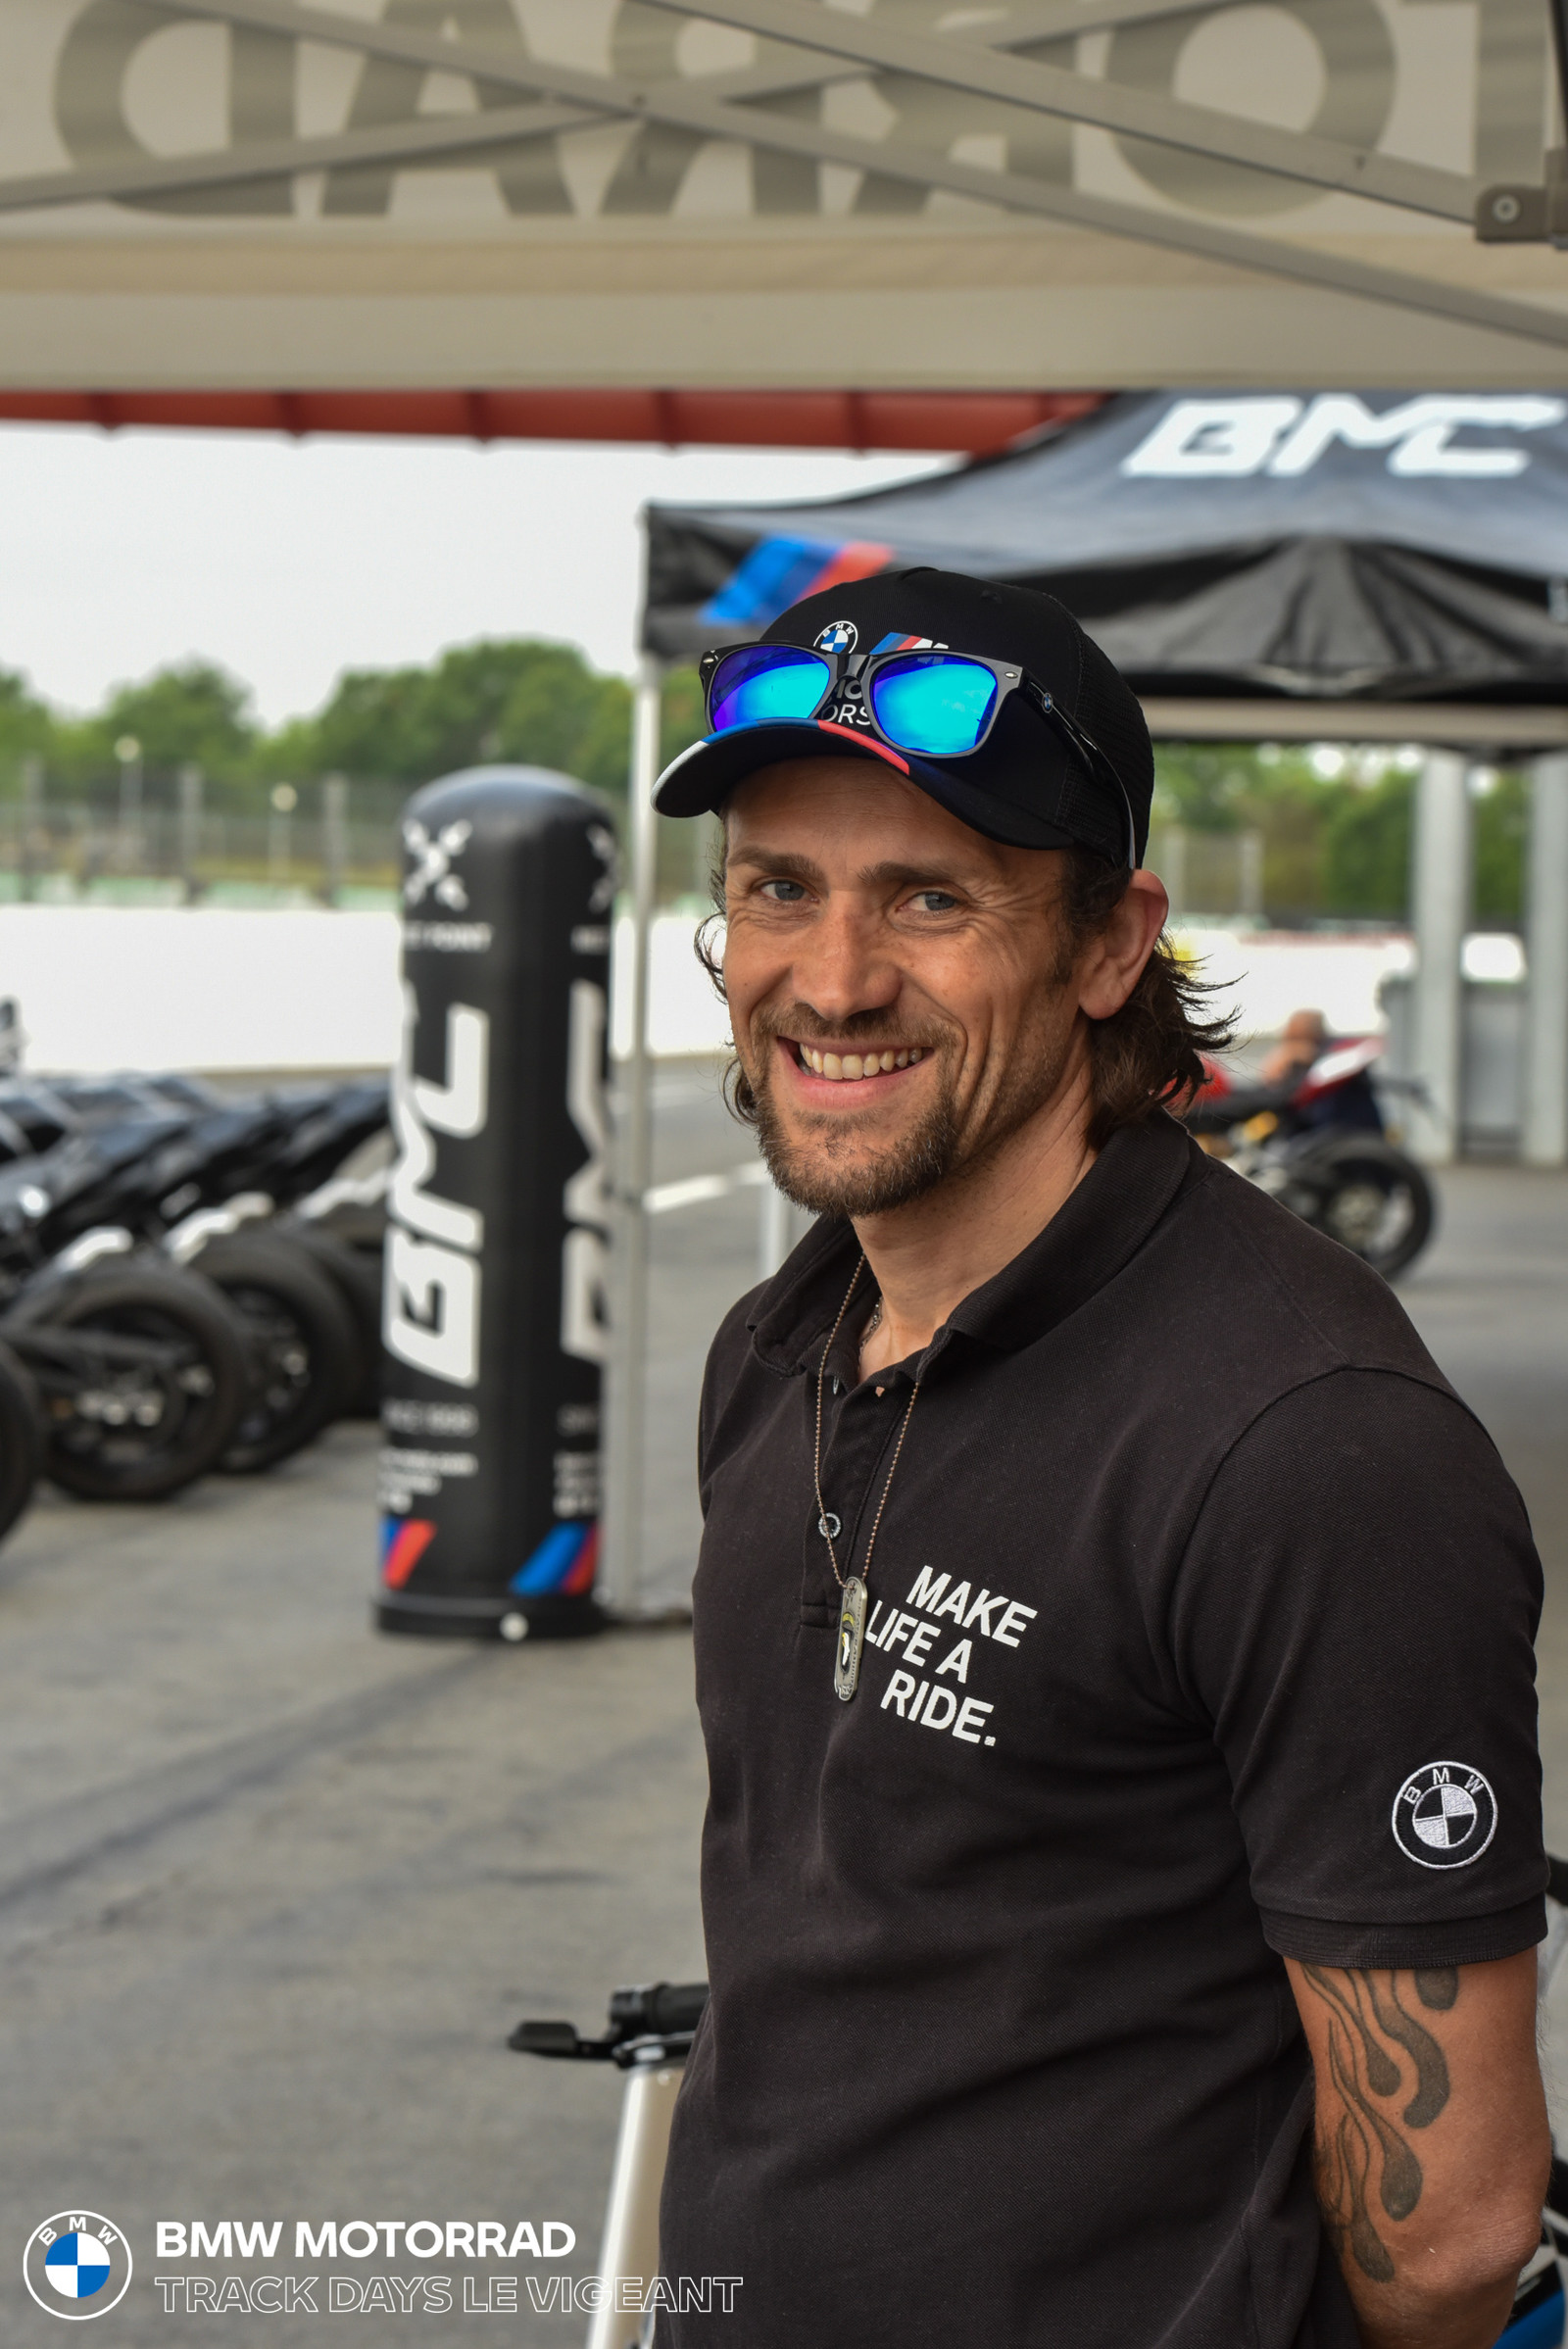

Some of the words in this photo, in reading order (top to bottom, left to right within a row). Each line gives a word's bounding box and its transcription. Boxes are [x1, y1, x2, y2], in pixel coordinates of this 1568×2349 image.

[1124, 394, 1565, 475] BMC
[864, 1599, 941, 1667] LIFE
[935, 1639, 973, 1684] A
[906, 1565, 1038, 1648] MAKE
[880, 1669, 996, 1747] RIDE.
[1403, 1767, 1484, 1804] BMW
